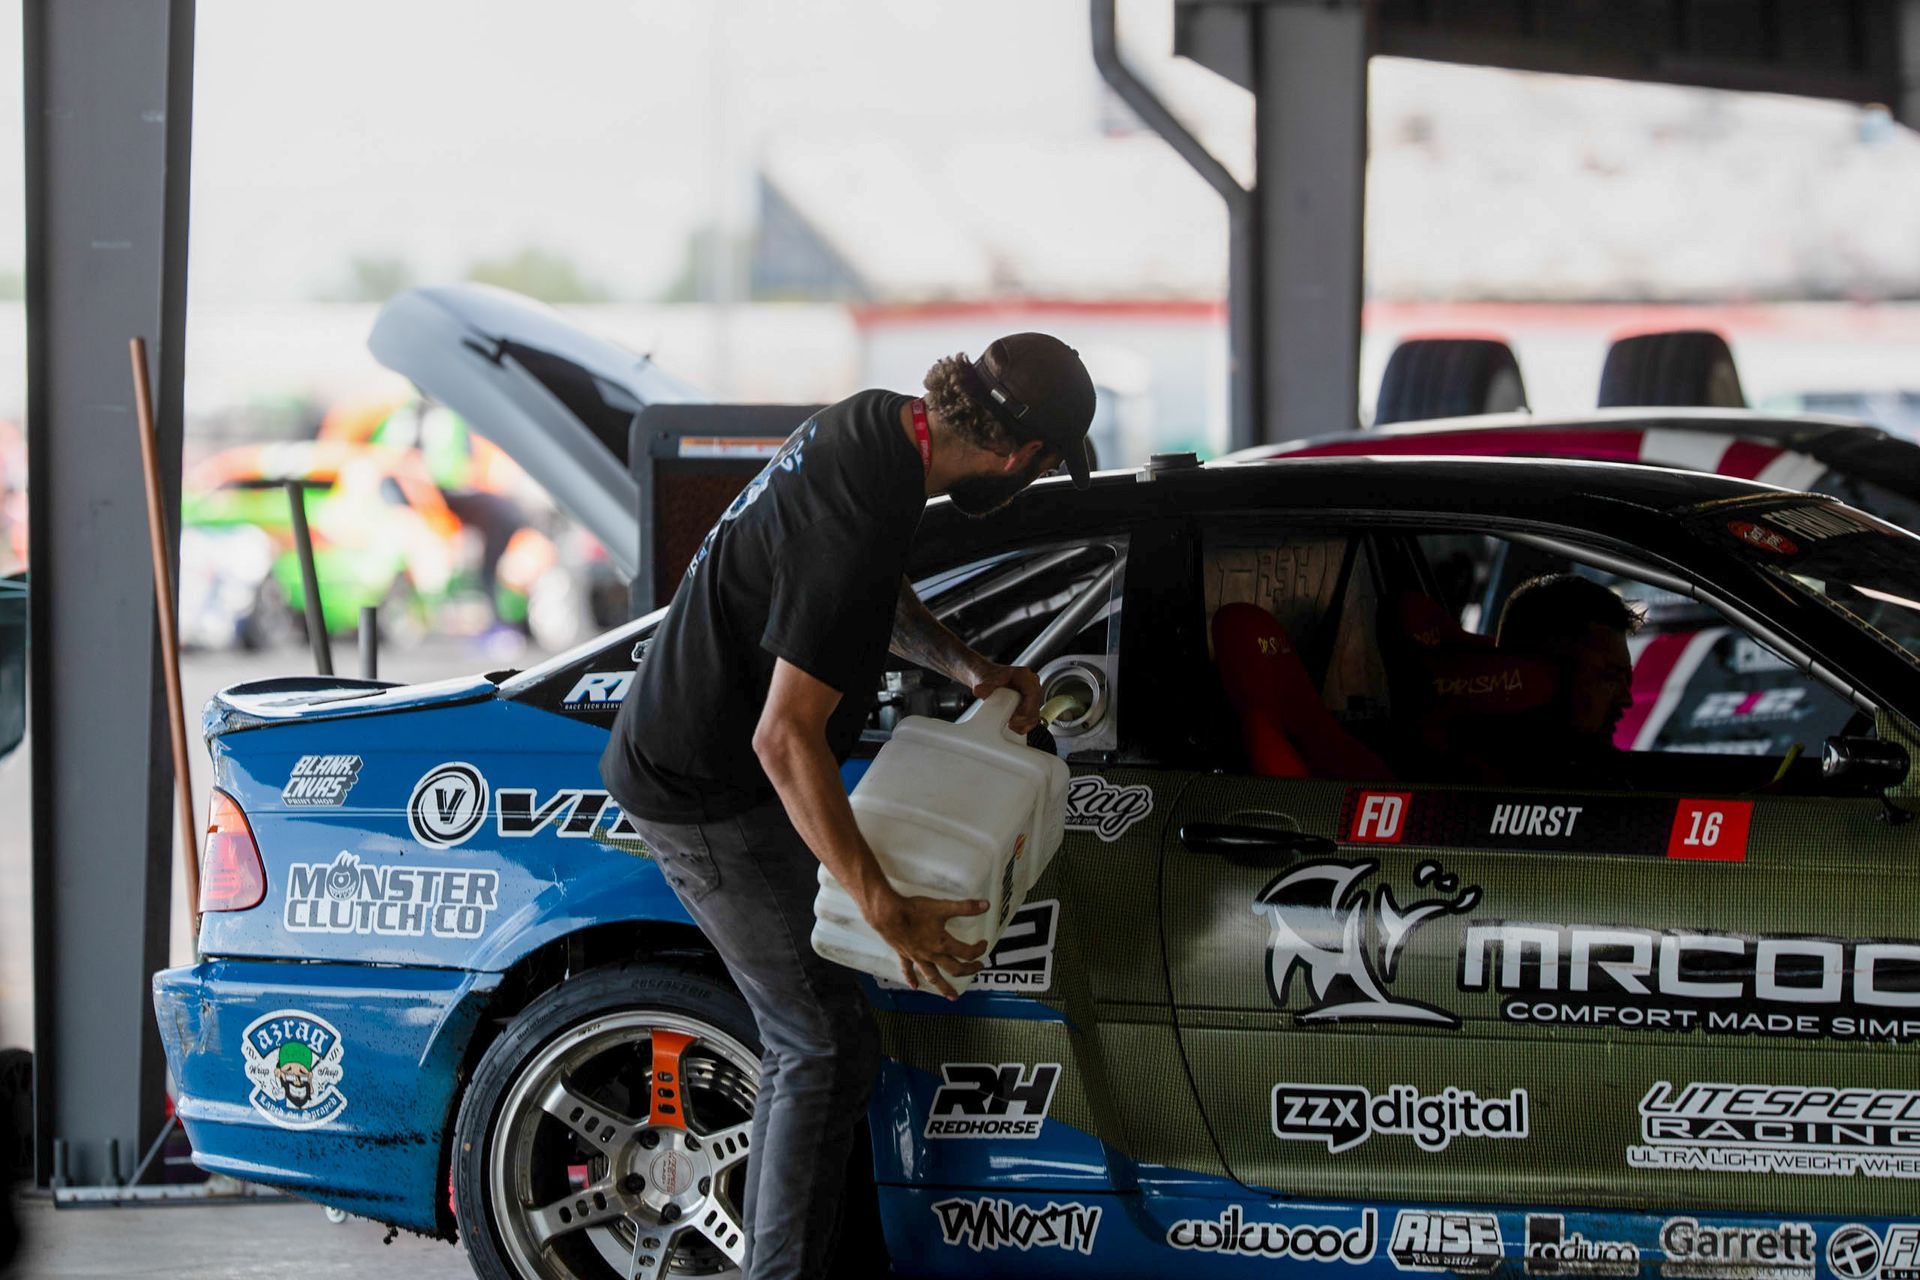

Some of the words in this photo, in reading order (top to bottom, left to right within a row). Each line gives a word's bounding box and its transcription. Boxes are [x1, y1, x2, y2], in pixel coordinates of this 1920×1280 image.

[282, 776, 347, 797] CNVAS
[1357, 796, 1402, 838] FD
[1490, 804, 1582, 837] HURST
[1684, 811, 1723, 847] 16
[291, 855, 496, 905] MONSTER
[287, 899, 425, 931] CLUTCH
[434, 905, 483, 934] CO
[1506, 1002, 1697, 1028] COMFORT
[1709, 1011, 1820, 1034] MADE
[933, 1066, 1059, 1115] RH
[928, 1120, 1039, 1135] REDHORSE
[1372, 1089, 1524, 1145] digital
[1631, 1149, 1705, 1164] ULTRA
[935, 1200, 1098, 1251] DYNOSTY
[1170, 1208, 1375, 1260] wilwood
[1393, 1214, 1501, 1255] RISE
[1664, 1220, 1812, 1262] Garrett
[1756, 1267, 1812, 1278] MOTION
